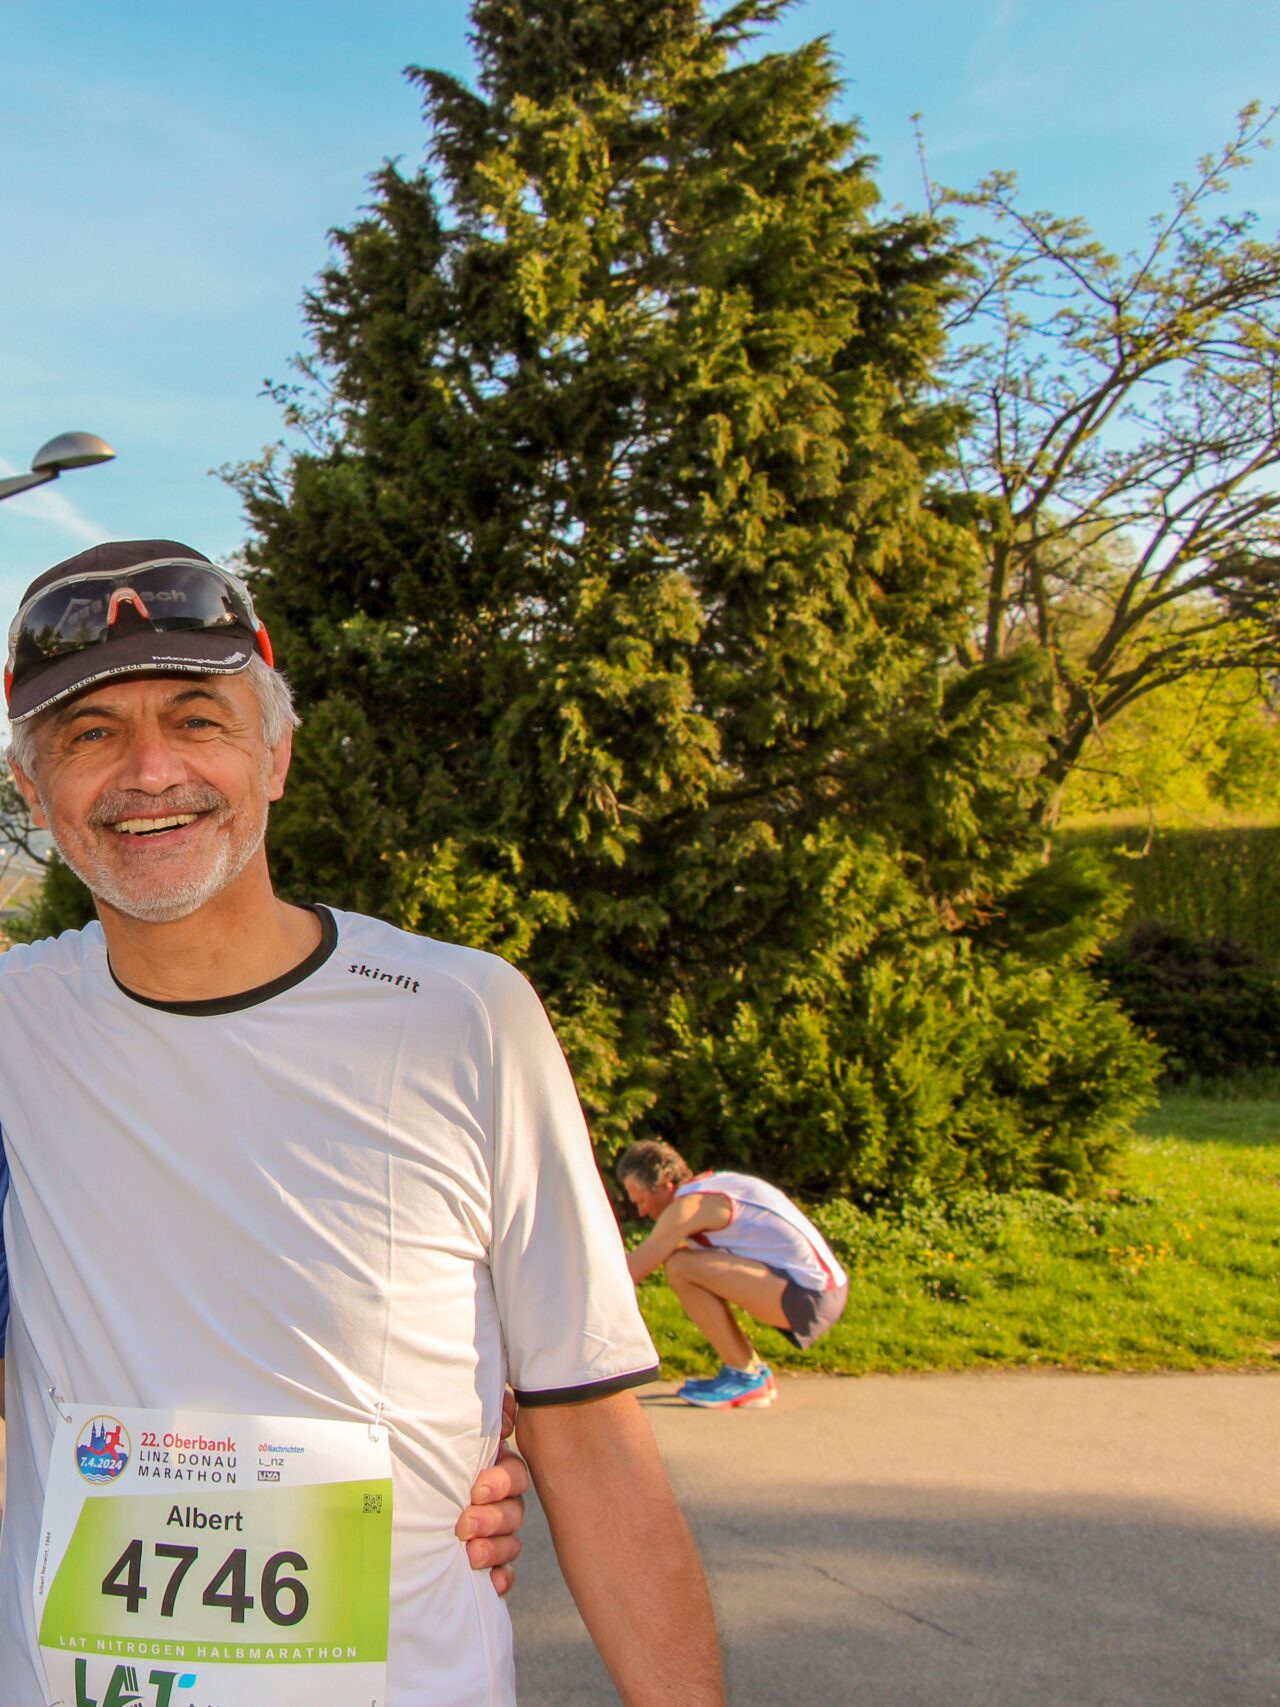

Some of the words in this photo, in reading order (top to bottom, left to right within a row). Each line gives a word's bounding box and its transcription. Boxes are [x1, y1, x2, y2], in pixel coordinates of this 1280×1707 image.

[348, 964, 420, 994] skinfit
[140, 1432, 160, 1448] 22.
[162, 1433, 236, 1453] Oberbank
[80, 1456, 123, 1470] 7.4.2024
[139, 1450, 170, 1464] LINZ
[177, 1453, 237, 1469] DONAU
[138, 1465, 237, 1484] MARATHON
[166, 1505, 243, 1532] Albert
[101, 1538, 310, 1627] 4746
[59, 1635, 87, 1648] LAT
[96, 1639, 186, 1657] NITROGEN
[196, 1646, 358, 1660] HALBMARATHON
